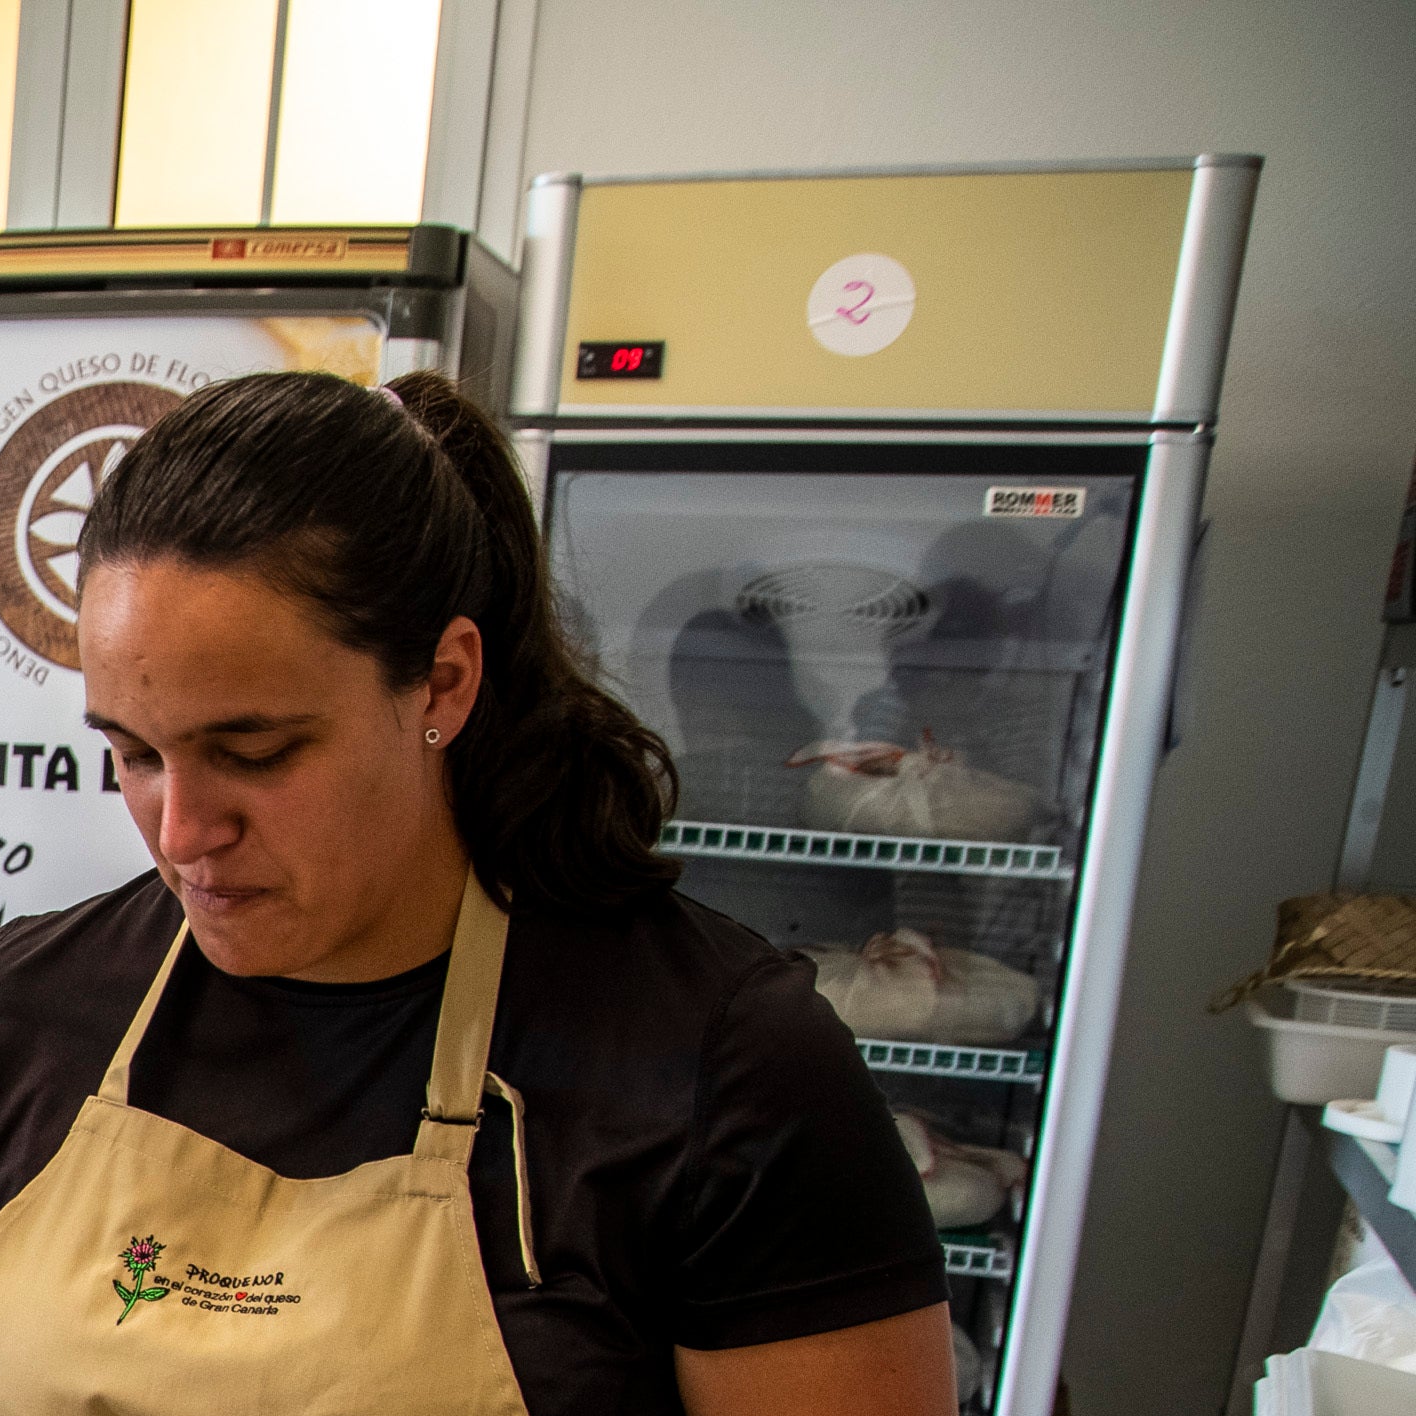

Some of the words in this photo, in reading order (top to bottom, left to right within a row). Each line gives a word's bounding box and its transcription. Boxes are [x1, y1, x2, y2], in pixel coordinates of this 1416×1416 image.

[835, 281, 875, 326] 2
[39, 352, 121, 394] QUESO
[131, 352, 160, 377] DE
[165, 359, 211, 390] FLO
[993, 492, 1077, 507] ROMMER
[186, 1264, 284, 1288] PROQUENOR
[154, 1275, 170, 1286] en
[171, 1281, 184, 1291] el
[184, 1286, 234, 1301] corazón
[245, 1293, 264, 1302] del
[264, 1294, 302, 1305] queso
[182, 1297, 197, 1306] de
[199, 1301, 229, 1312] Gran
[231, 1304, 278, 1315] Canaria
